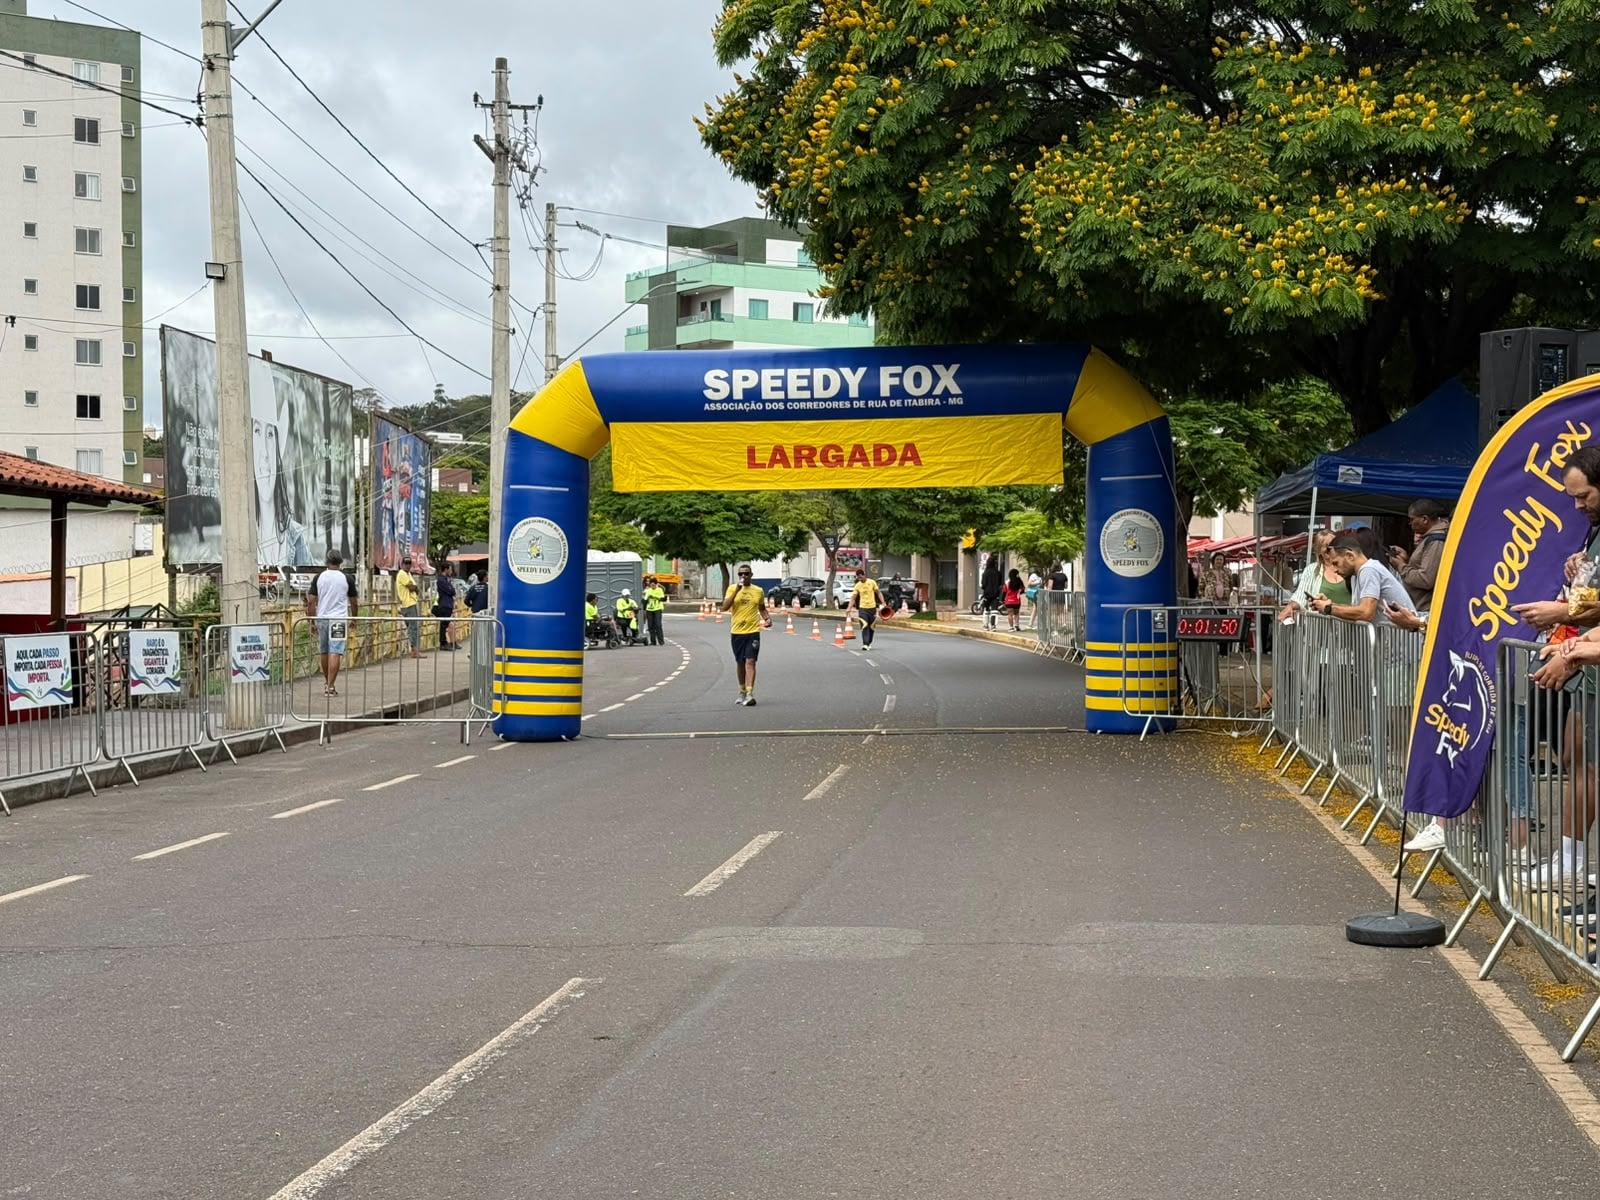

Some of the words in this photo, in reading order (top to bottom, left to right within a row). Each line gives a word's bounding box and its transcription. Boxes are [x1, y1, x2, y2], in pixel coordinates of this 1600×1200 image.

[703, 367, 867, 400] SPEEDY
[880, 364, 962, 397] FOX
[704, 401, 763, 412] ASSOCIAÇÃO
[787, 401, 850, 409] CORREDORES
[904, 398, 940, 406] ITABIRA
[746, 442, 922, 469] LARGADA
[1469, 496, 1562, 641] Speedy
[1524, 420, 1592, 492] Fox
[1178, 618, 1238, 634] 0:01:50
[29, 648, 42, 659] CADA
[42, 648, 59, 658] PASSO
[34, 660, 46, 670] CADA
[47, 659, 62, 669] PESSOA
[144, 658, 161, 666] GIGANTE
[28, 672, 50, 683] IMPORTA.
[1482, 672, 1496, 704] CORRIDA
[1490, 706, 1496, 718] DE
